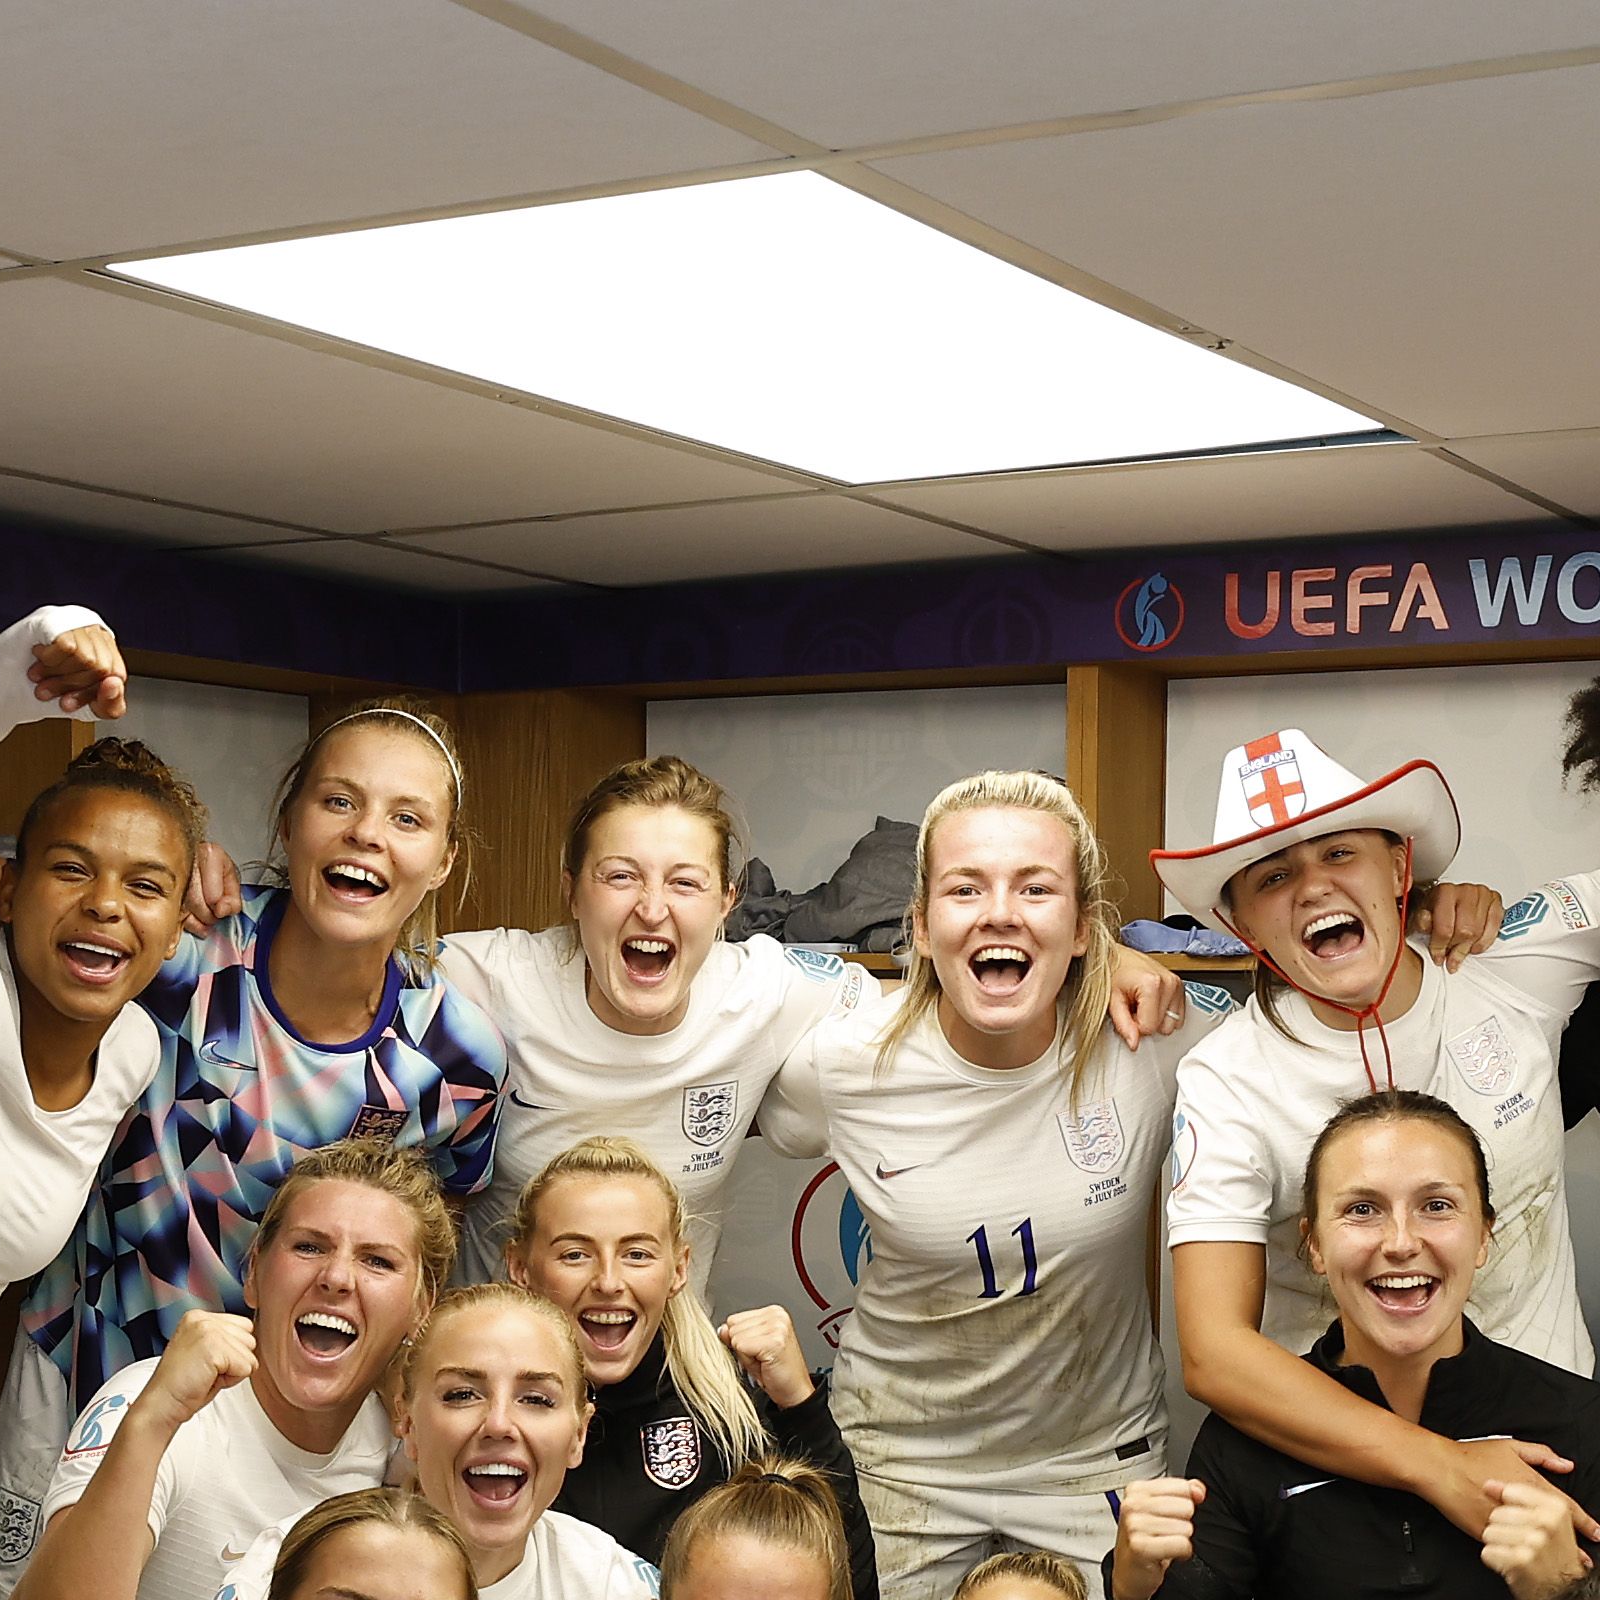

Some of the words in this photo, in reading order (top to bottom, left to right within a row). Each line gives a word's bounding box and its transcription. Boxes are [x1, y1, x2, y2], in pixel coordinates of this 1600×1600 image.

[1225, 562, 1449, 640] UEFA
[1495, 1091, 1524, 1115] SWEDEN
[1503, 1107, 1520, 1124] JULY
[691, 1151, 721, 1163] SWEDEN
[692, 1161, 710, 1173] JULY
[1089, 1176, 1121, 1194] SWEDEN
[1094, 1190, 1112, 1204] JULY
[965, 1216, 1038, 1299] 11
